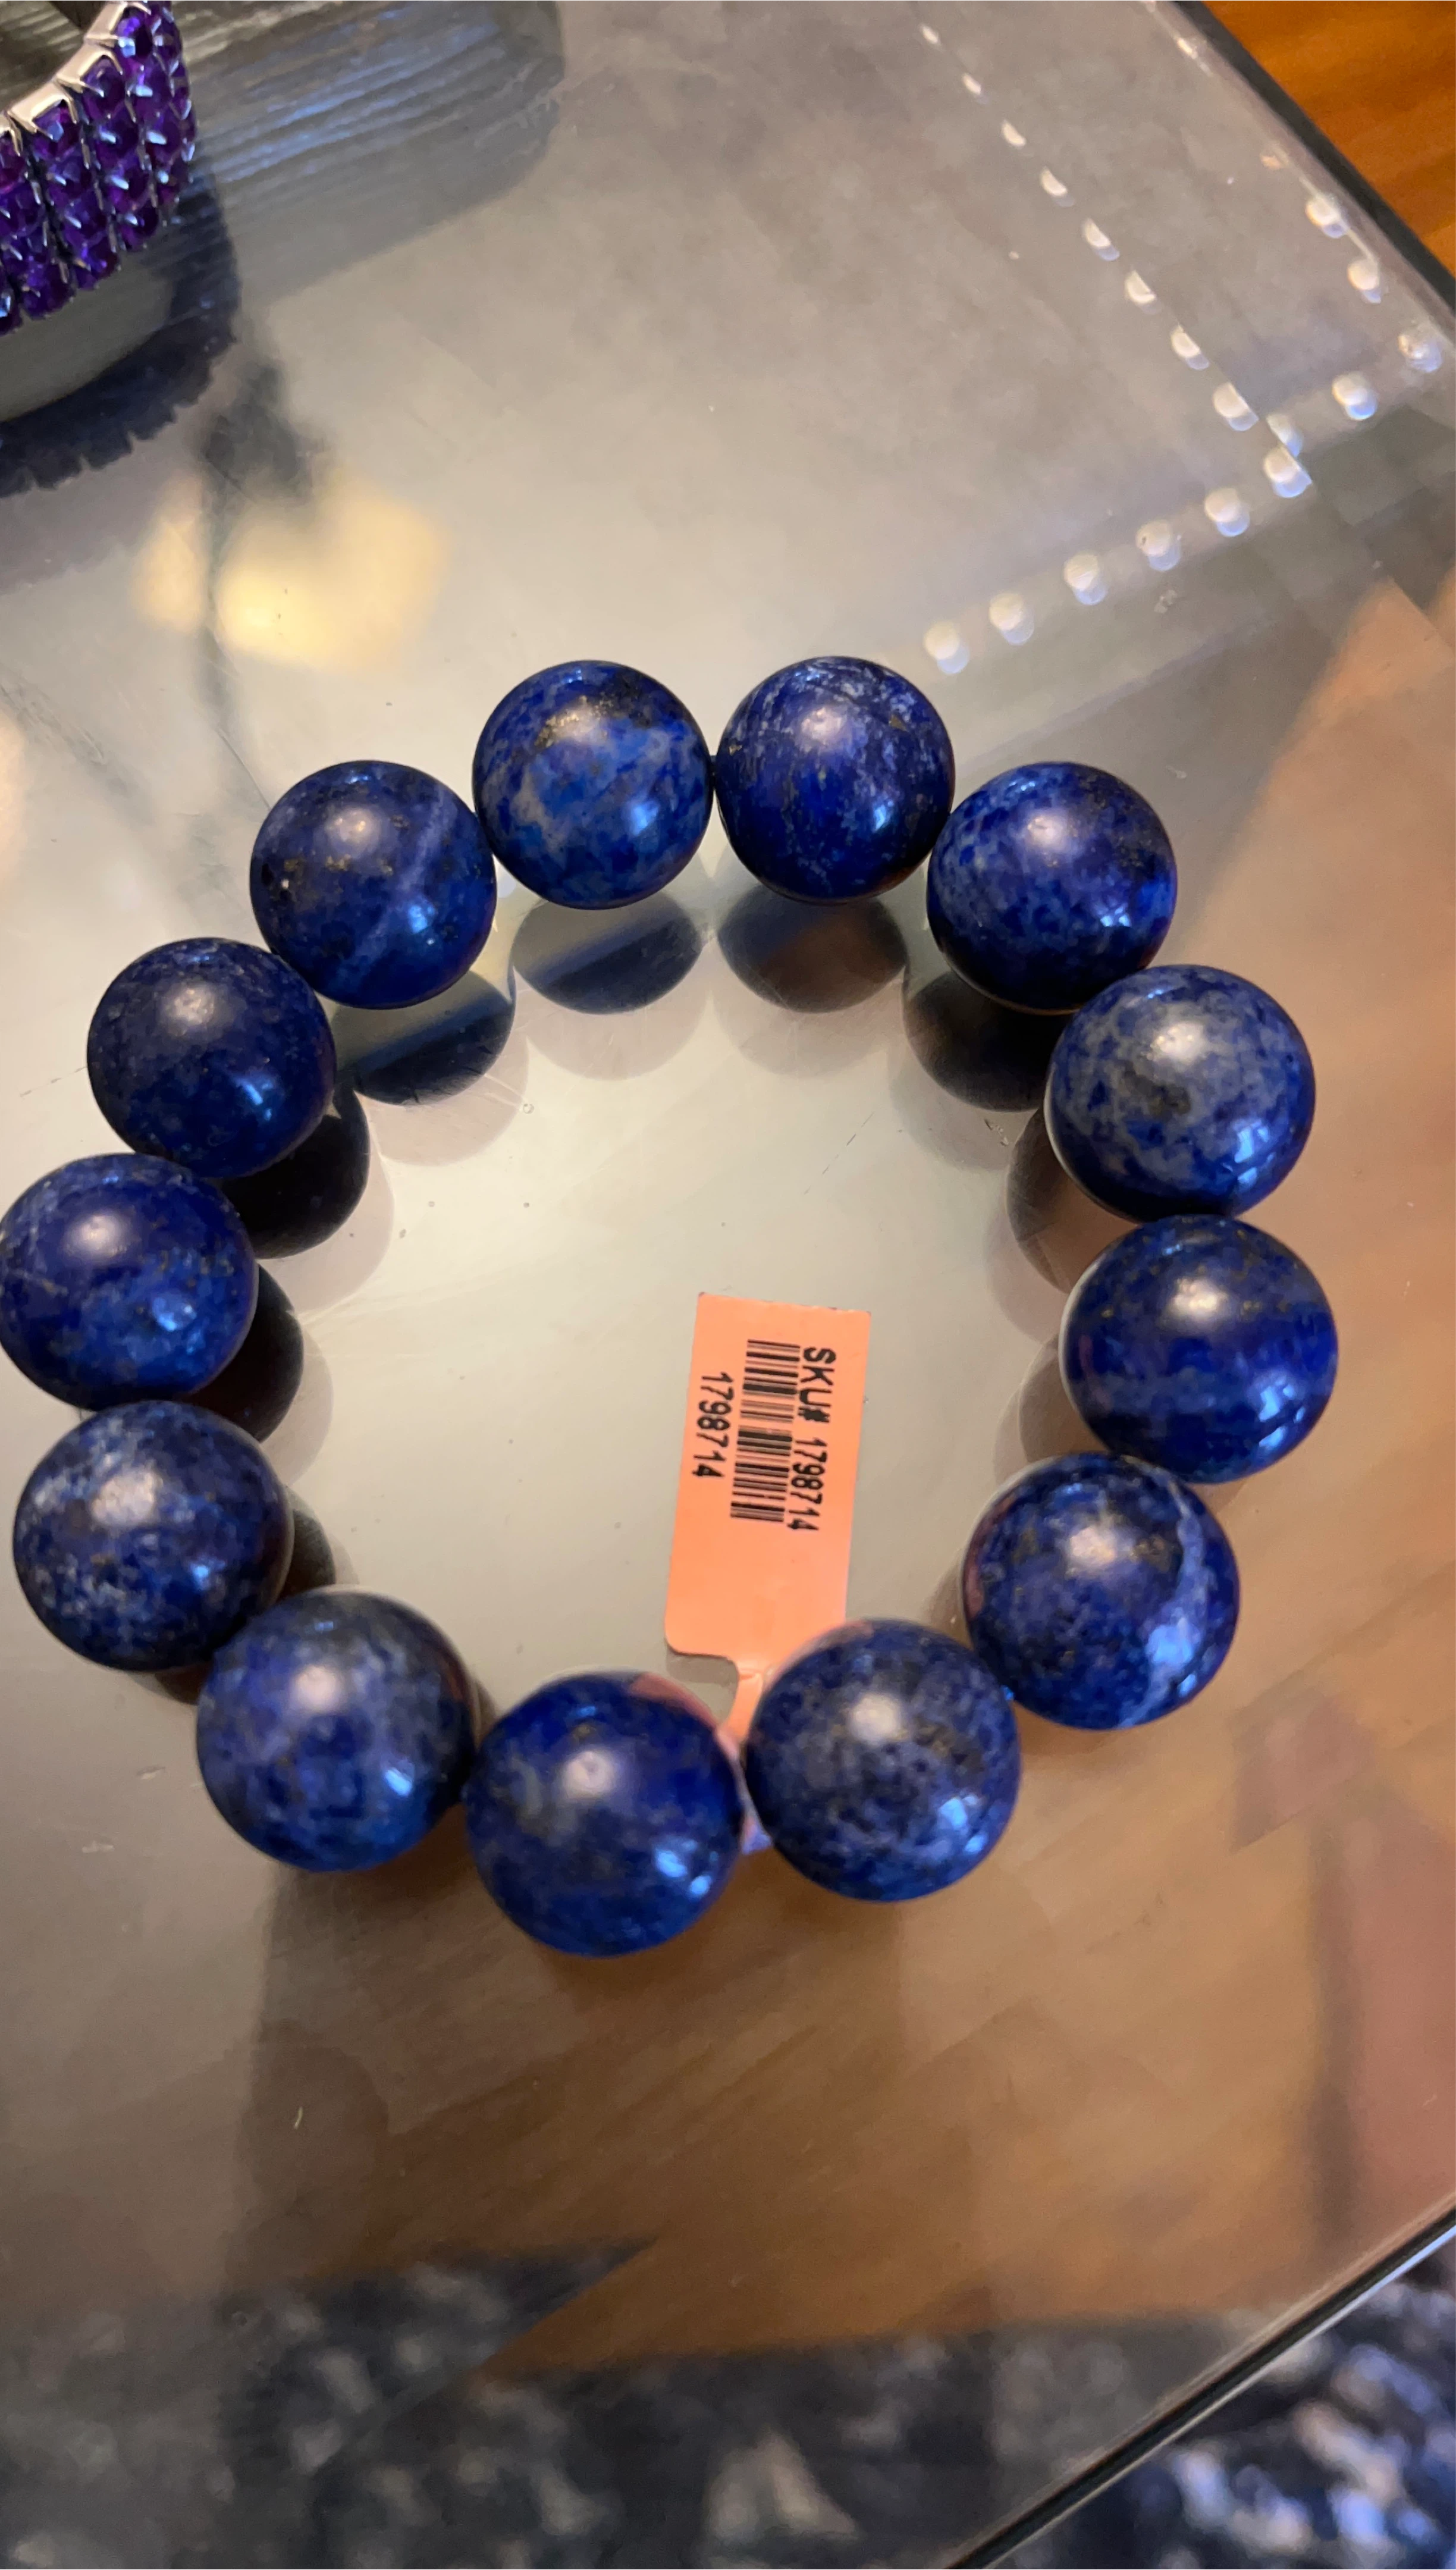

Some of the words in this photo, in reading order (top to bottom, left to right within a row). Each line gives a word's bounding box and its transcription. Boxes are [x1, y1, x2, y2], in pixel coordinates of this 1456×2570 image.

[692, 1371, 735, 1478] 1798714
[798, 1347, 837, 1423] SKU#
[787, 1437, 829, 1531] 1798714
